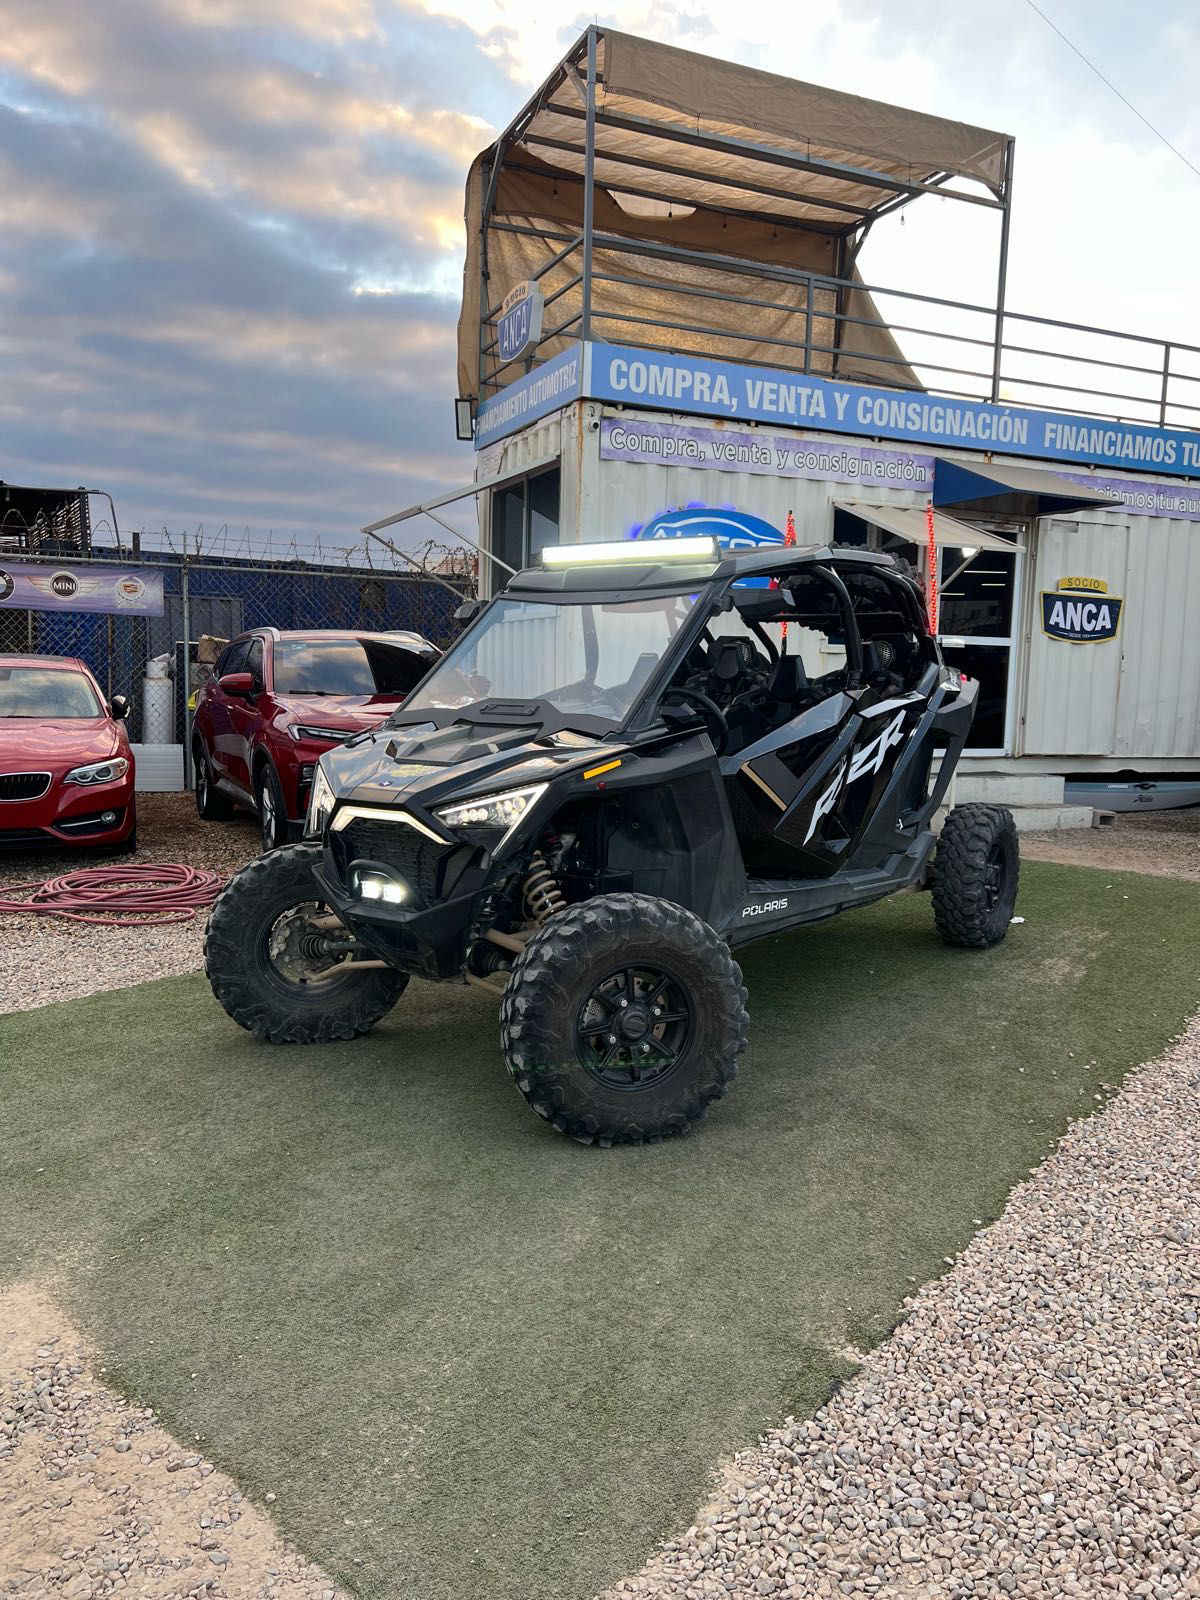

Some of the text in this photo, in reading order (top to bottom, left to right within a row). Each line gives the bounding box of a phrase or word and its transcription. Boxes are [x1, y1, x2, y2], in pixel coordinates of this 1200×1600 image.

[503, 304, 527, 352] ANCA
[529, 360, 577, 408] AUTOMOTRIZ
[609, 358, 1028, 445] COMPRA, VENTA Y CONSIGNACIÓN
[609, 426, 926, 482] Compra, venta y consignación
[1044, 422, 1177, 465] FINANCIAMOS
[1159, 493, 1175, 512] tu
[1179, 498, 1200, 513] au
[53, 581, 76, 591] MINI
[1067, 577, 1100, 589] SOCIO
[1049, 600, 1112, 632] ANCA
[742, 898, 788, 918] POLARIS
